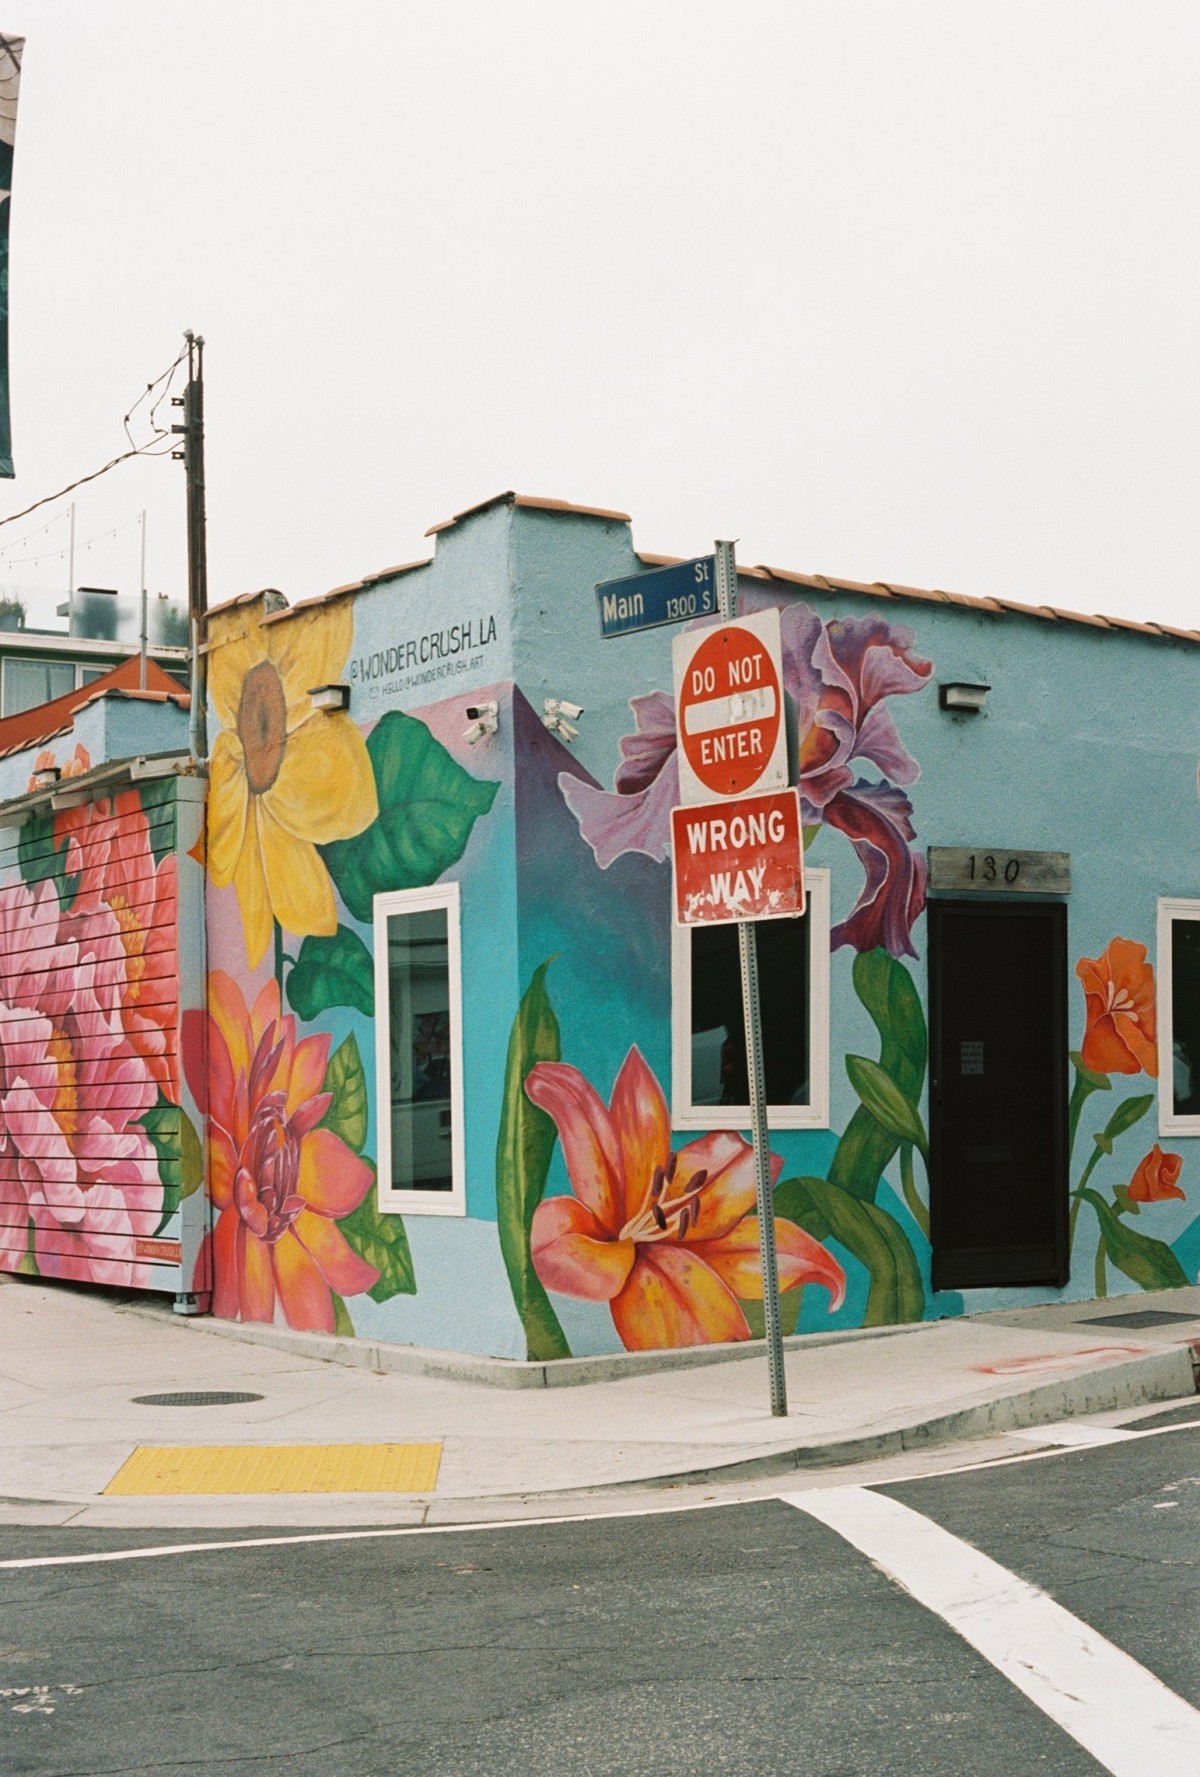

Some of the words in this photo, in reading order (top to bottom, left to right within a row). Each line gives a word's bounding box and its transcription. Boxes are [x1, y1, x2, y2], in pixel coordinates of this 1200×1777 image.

[694, 563, 709, 583] St
[603, 592, 644, 623] Main
[666, 596, 696, 619] 1300
[702, 591, 711, 610] S
[692, 666, 715, 696] DO
[728, 654, 763, 687] NOT
[701, 728, 763, 765] ENTER
[686, 810, 785, 854] WRONG
[710, 866, 766, 905] WAY
[968, 854, 1020, 884] 130
